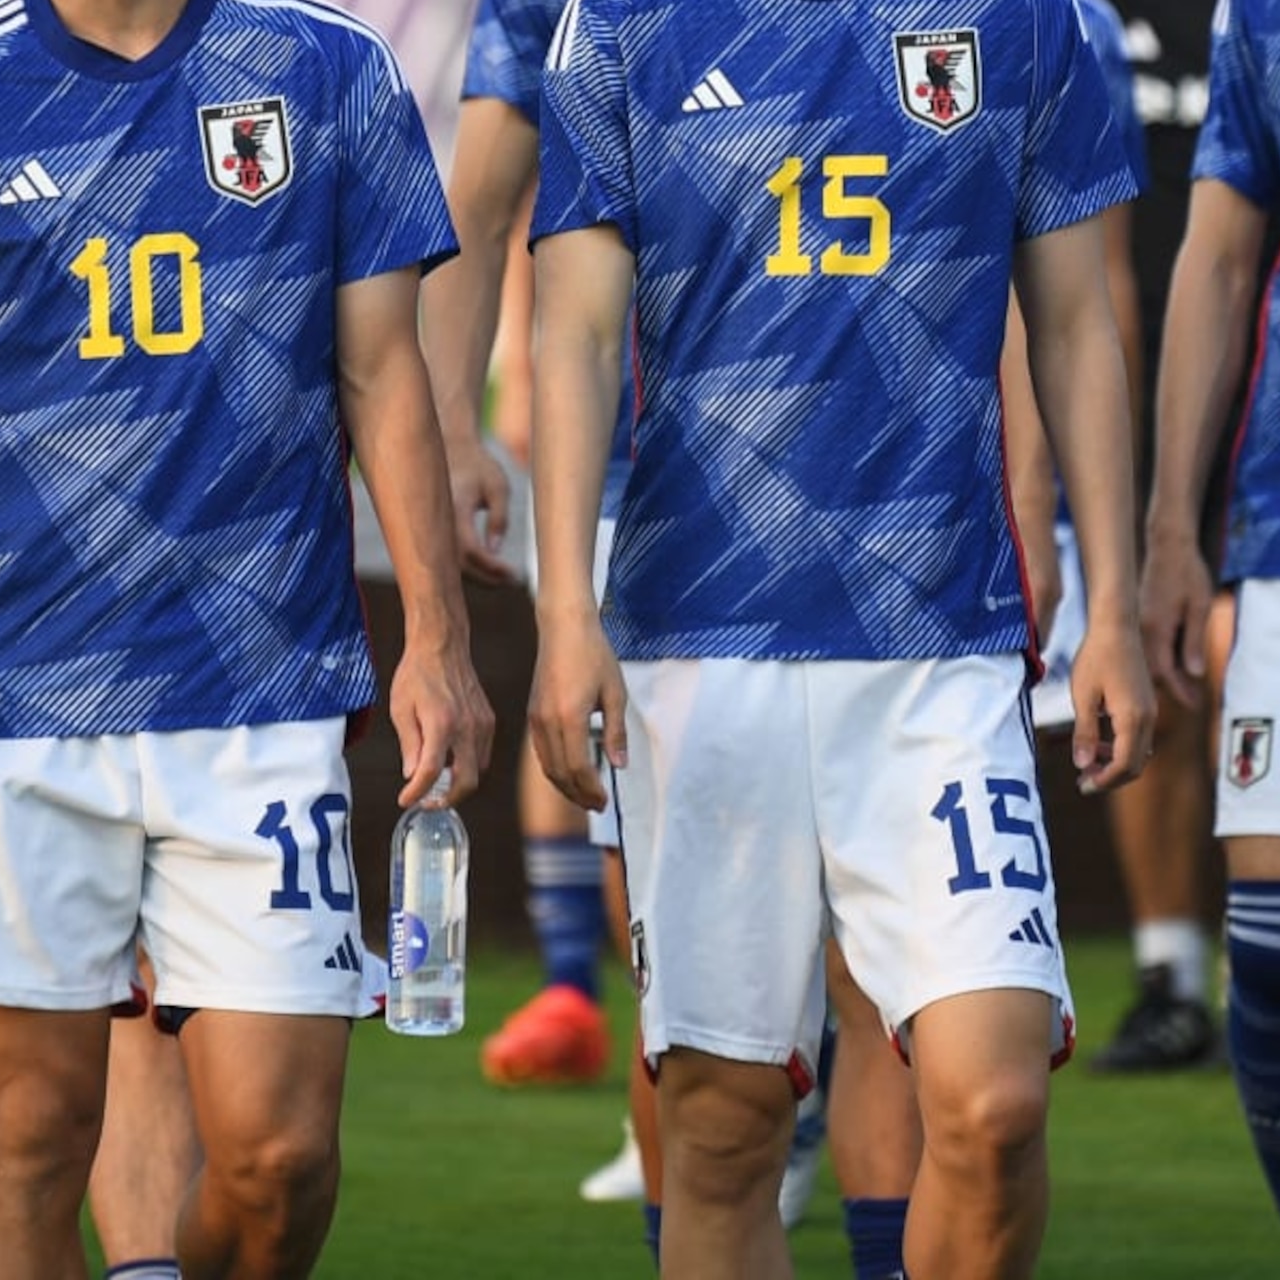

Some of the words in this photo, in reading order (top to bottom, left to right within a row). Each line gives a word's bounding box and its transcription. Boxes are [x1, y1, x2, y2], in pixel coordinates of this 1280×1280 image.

[915, 33, 958, 45] JAPAN
[221, 103, 264, 118] JAPAN
[766, 156, 890, 276] 15
[71, 233, 203, 359] 10
[254, 793, 355, 912] 10
[930, 777, 1048, 895] 15
[391, 911, 404, 979] smart
